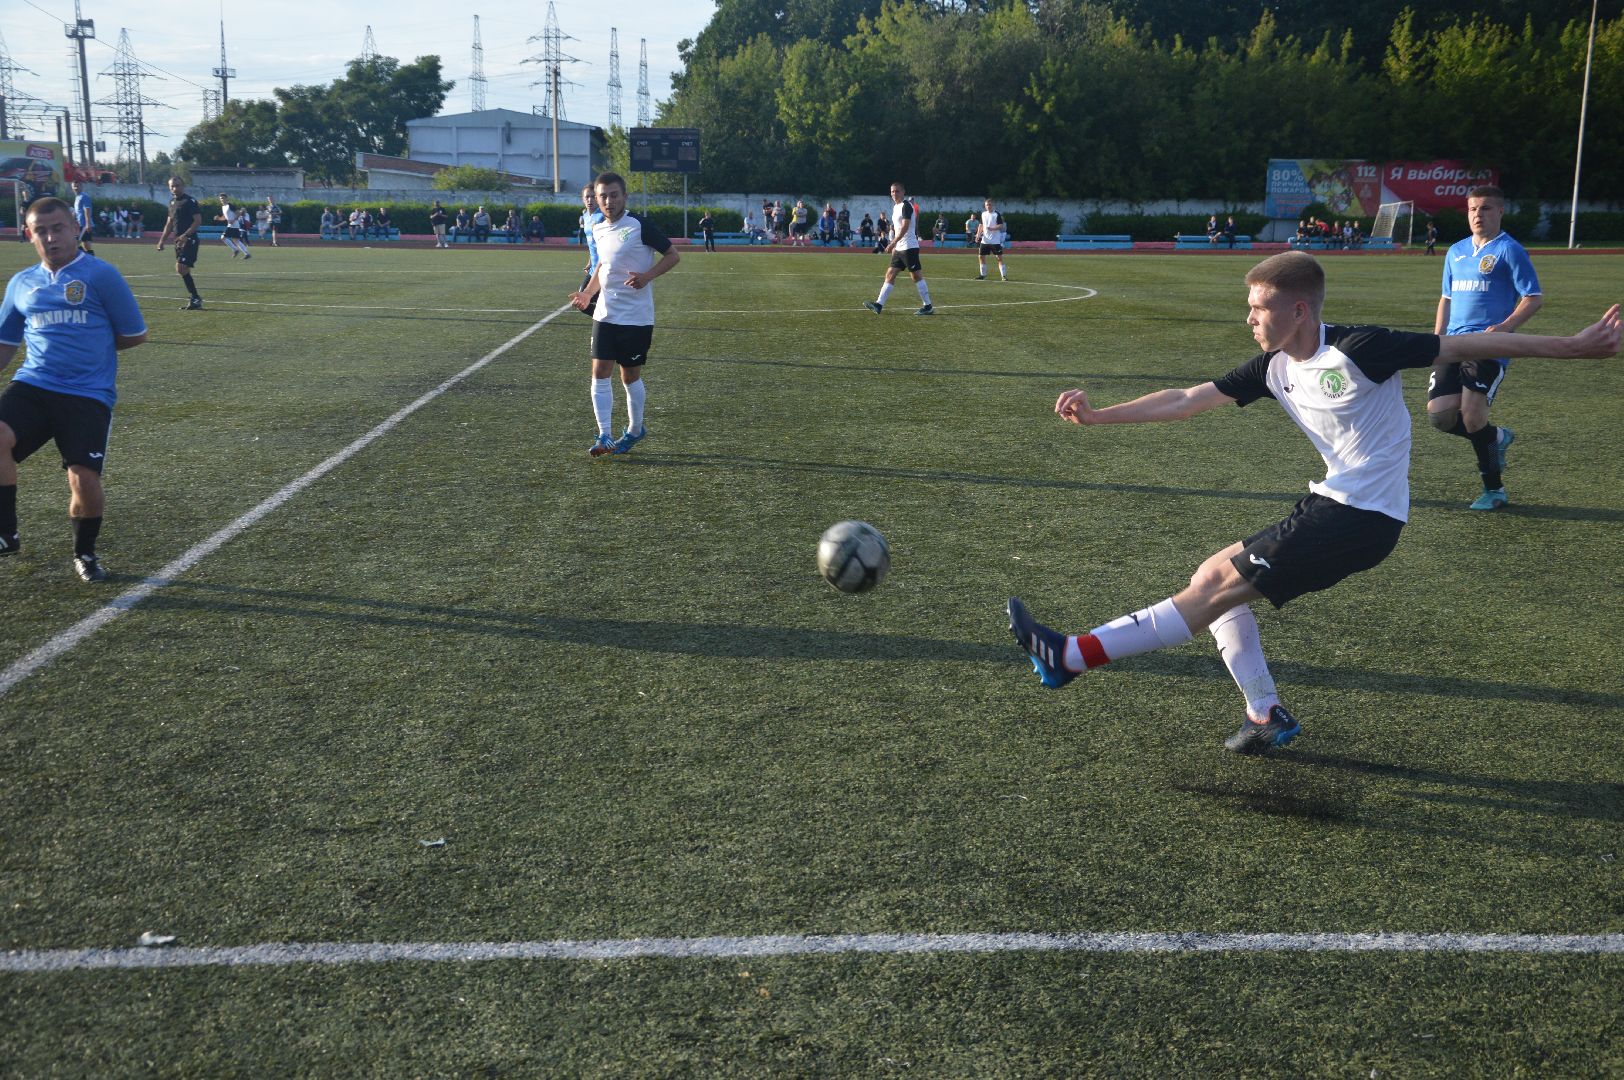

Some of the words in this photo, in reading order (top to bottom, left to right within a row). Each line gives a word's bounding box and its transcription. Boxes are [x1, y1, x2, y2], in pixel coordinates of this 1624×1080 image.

[1272, 169, 1304, 181] 80%
[1356, 166, 1377, 177] 112
[1390, 166, 1404, 180] Я
